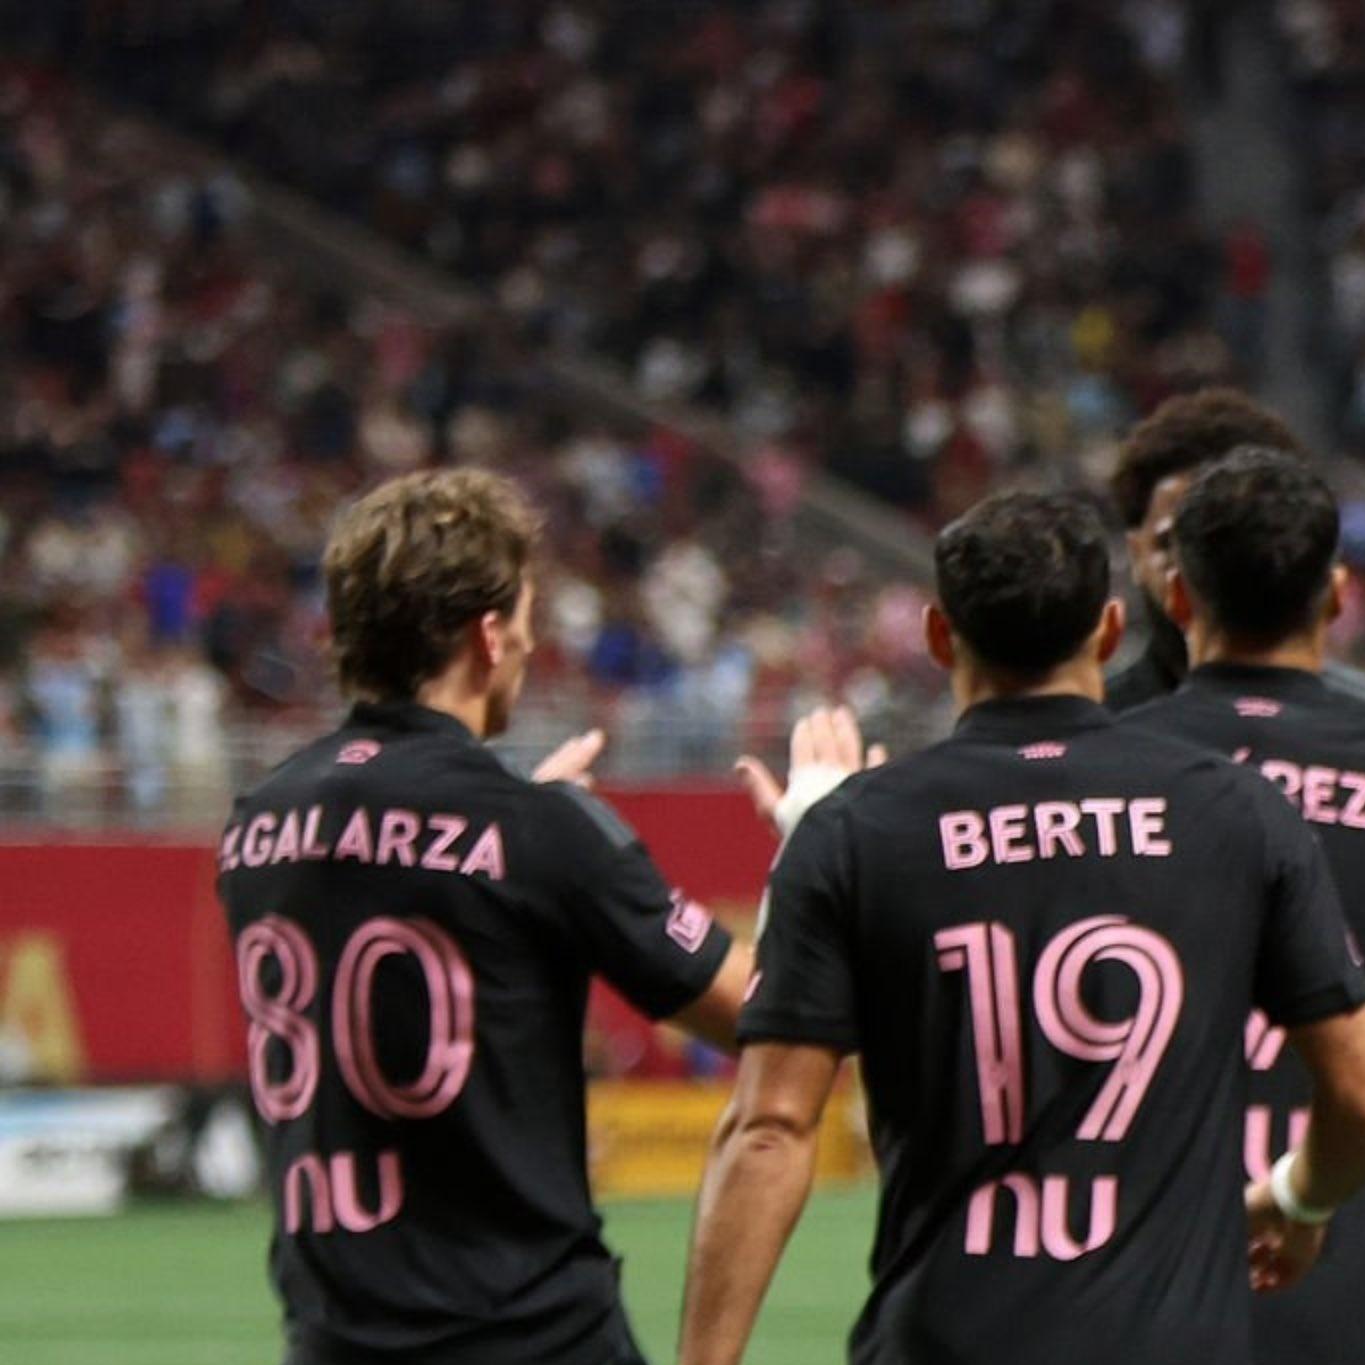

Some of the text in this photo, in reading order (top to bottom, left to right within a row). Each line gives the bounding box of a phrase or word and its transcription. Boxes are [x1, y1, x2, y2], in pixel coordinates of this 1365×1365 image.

[938, 798, 1172, 870] BERTE
[236, 913, 475, 1122] 80
[933, 914, 1184, 1145] 19
